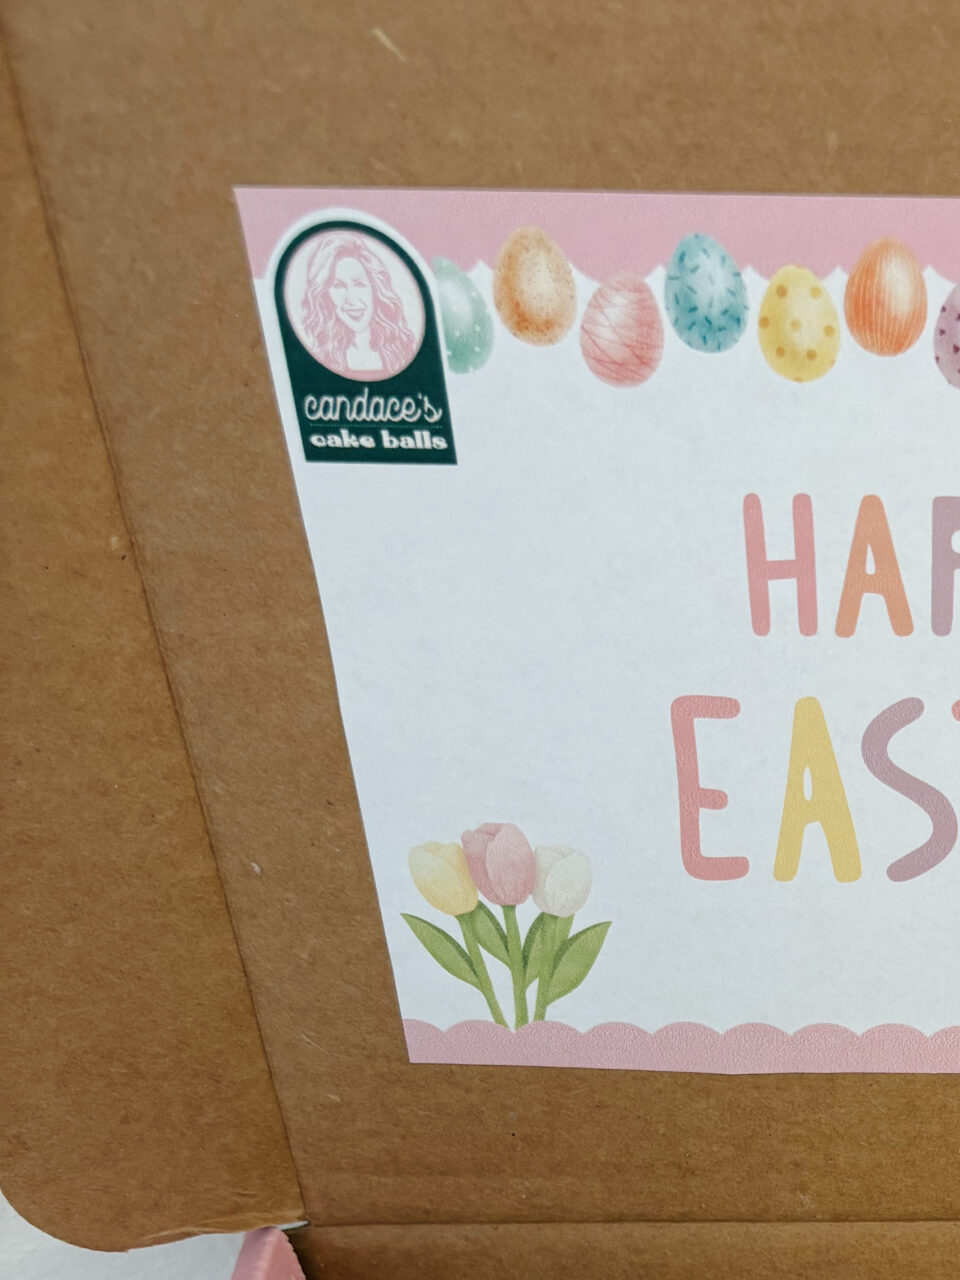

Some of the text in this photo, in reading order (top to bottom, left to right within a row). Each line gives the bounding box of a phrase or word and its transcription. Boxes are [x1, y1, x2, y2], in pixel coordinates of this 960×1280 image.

[304, 386, 442, 423] candace's
[310, 428, 448, 450] cake balls
